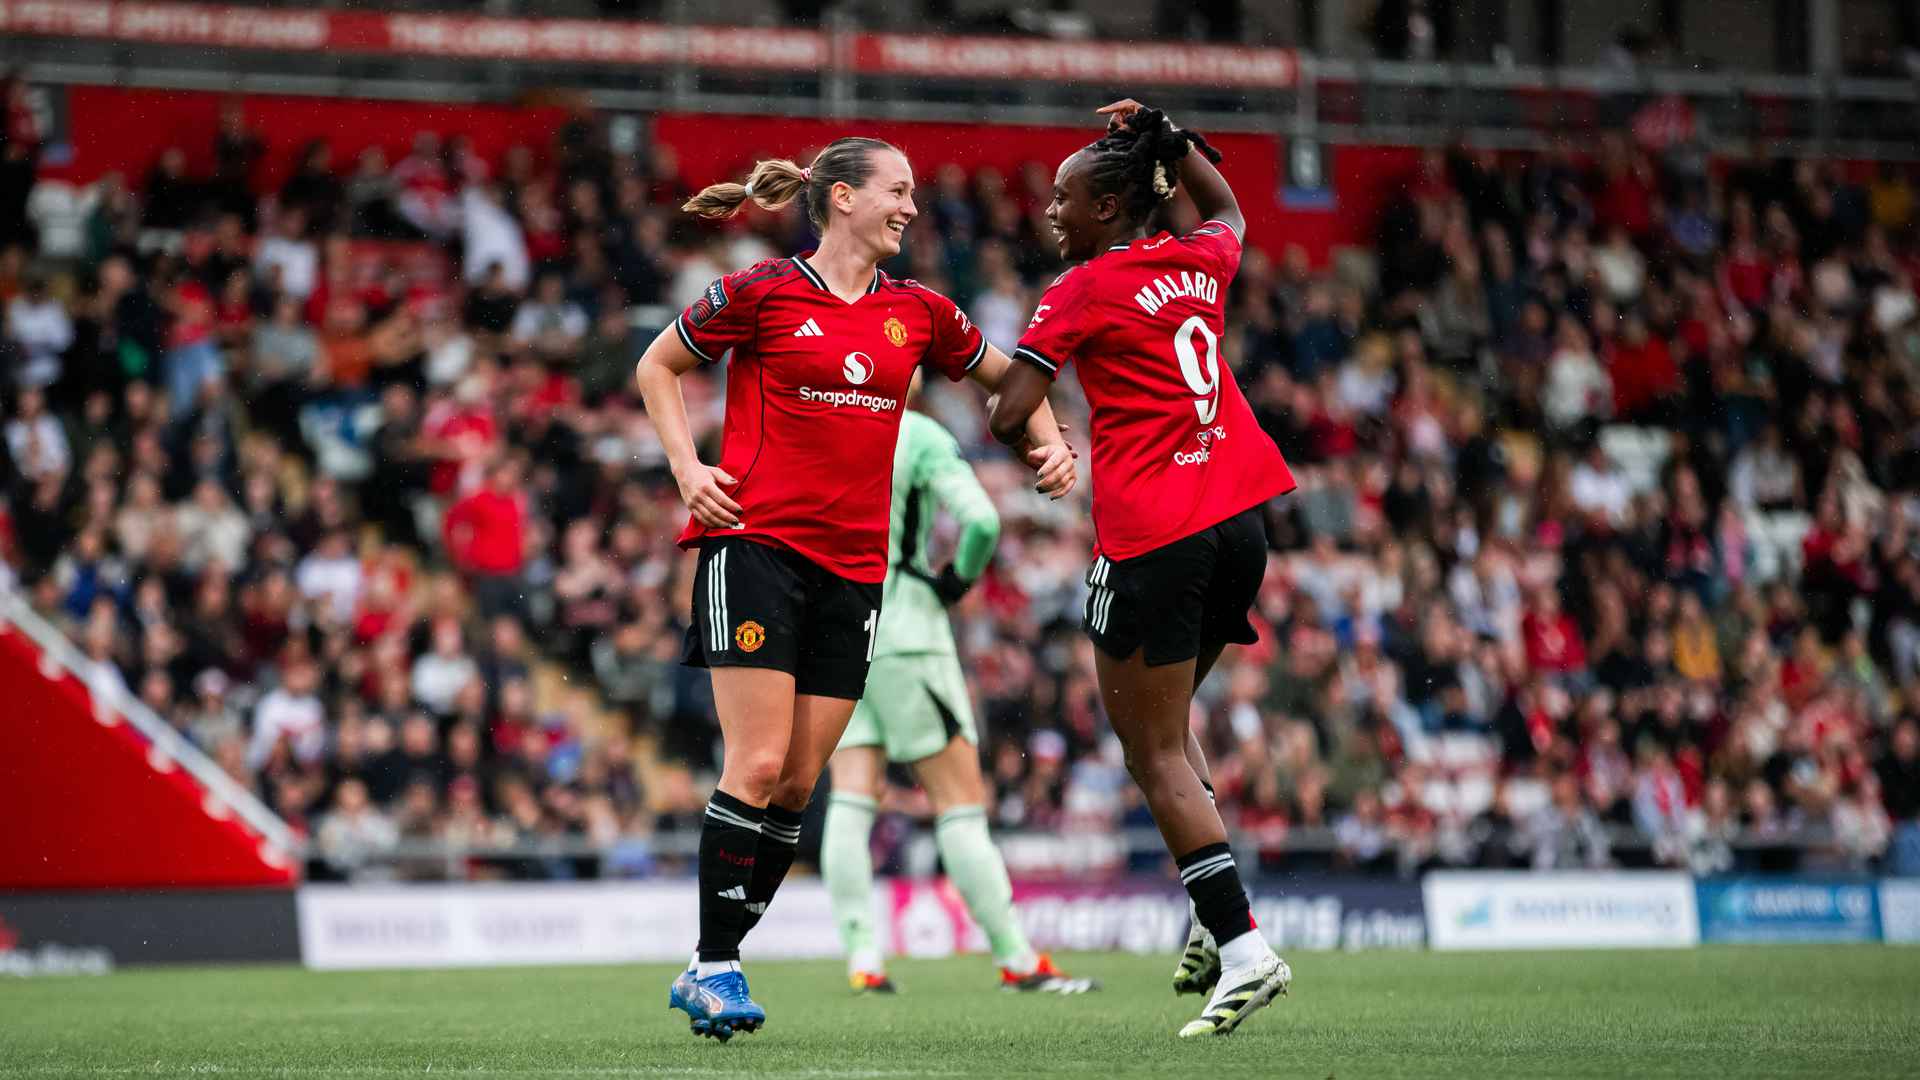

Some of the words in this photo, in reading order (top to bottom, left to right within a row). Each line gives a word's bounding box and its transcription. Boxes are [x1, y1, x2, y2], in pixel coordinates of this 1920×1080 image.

[1135, 271, 1219, 316] MALARD
[1174, 316, 1220, 426] 9
[799, 386, 897, 412] Snapdragon
